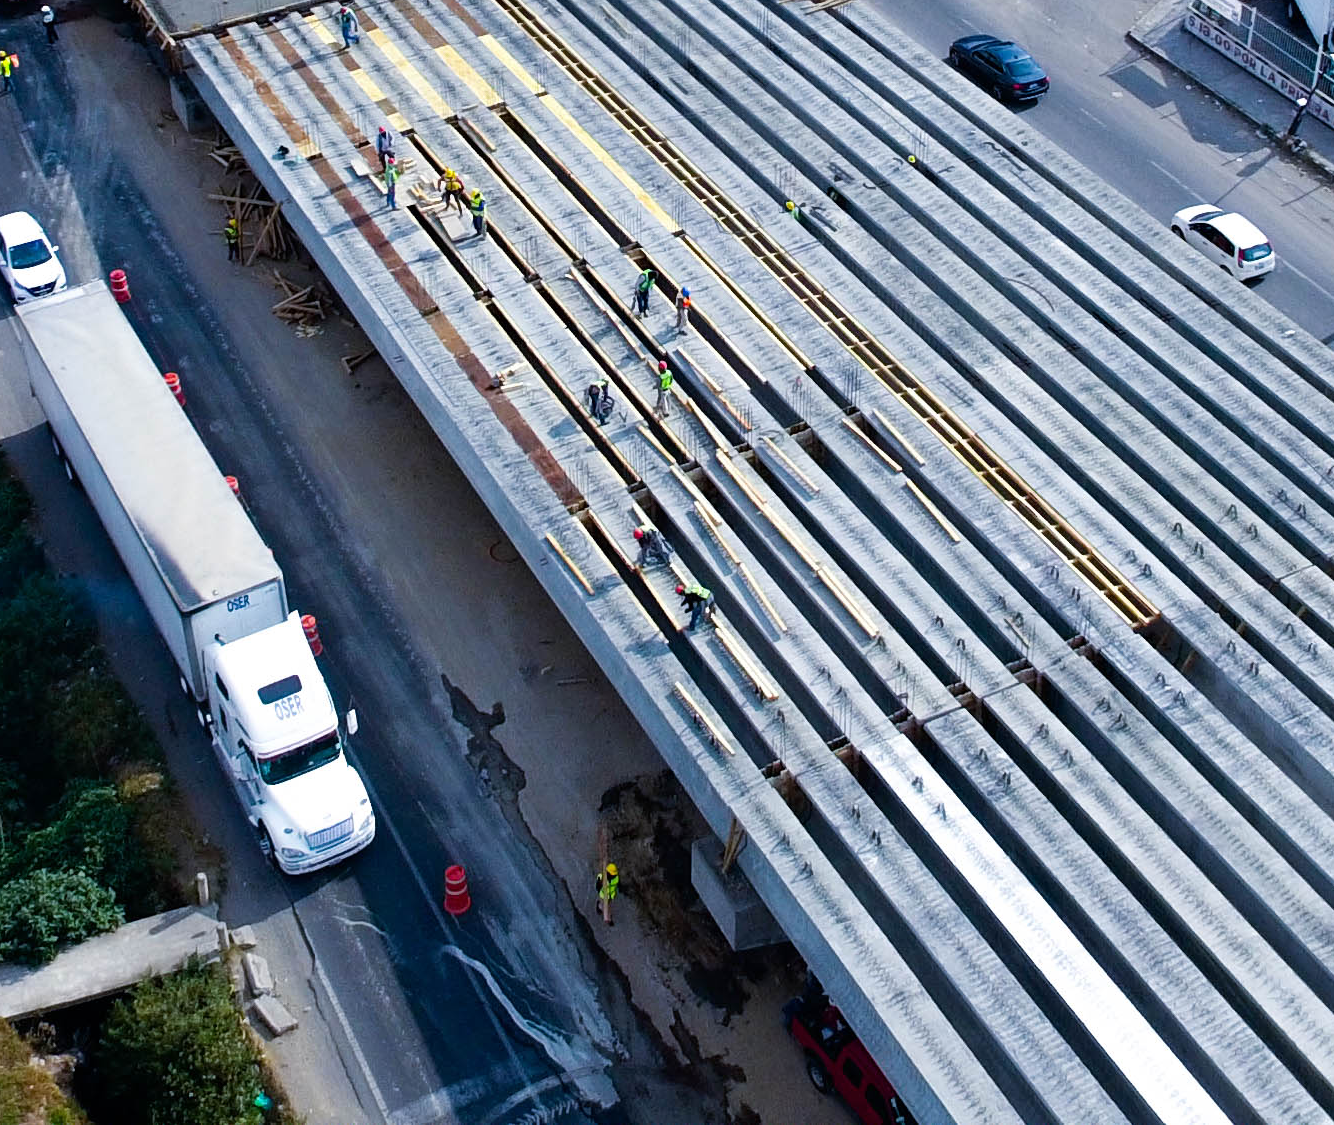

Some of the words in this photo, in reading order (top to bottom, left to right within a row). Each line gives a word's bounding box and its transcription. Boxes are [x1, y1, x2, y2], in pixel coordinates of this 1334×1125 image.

[1233, 48, 1257, 72] POR
[1260, 66, 1276, 85] LA
[1280, 78, 1330, 122] PRIMRA
[227, 595, 250, 612] OSER
[274, 695, 305, 721] OSER
